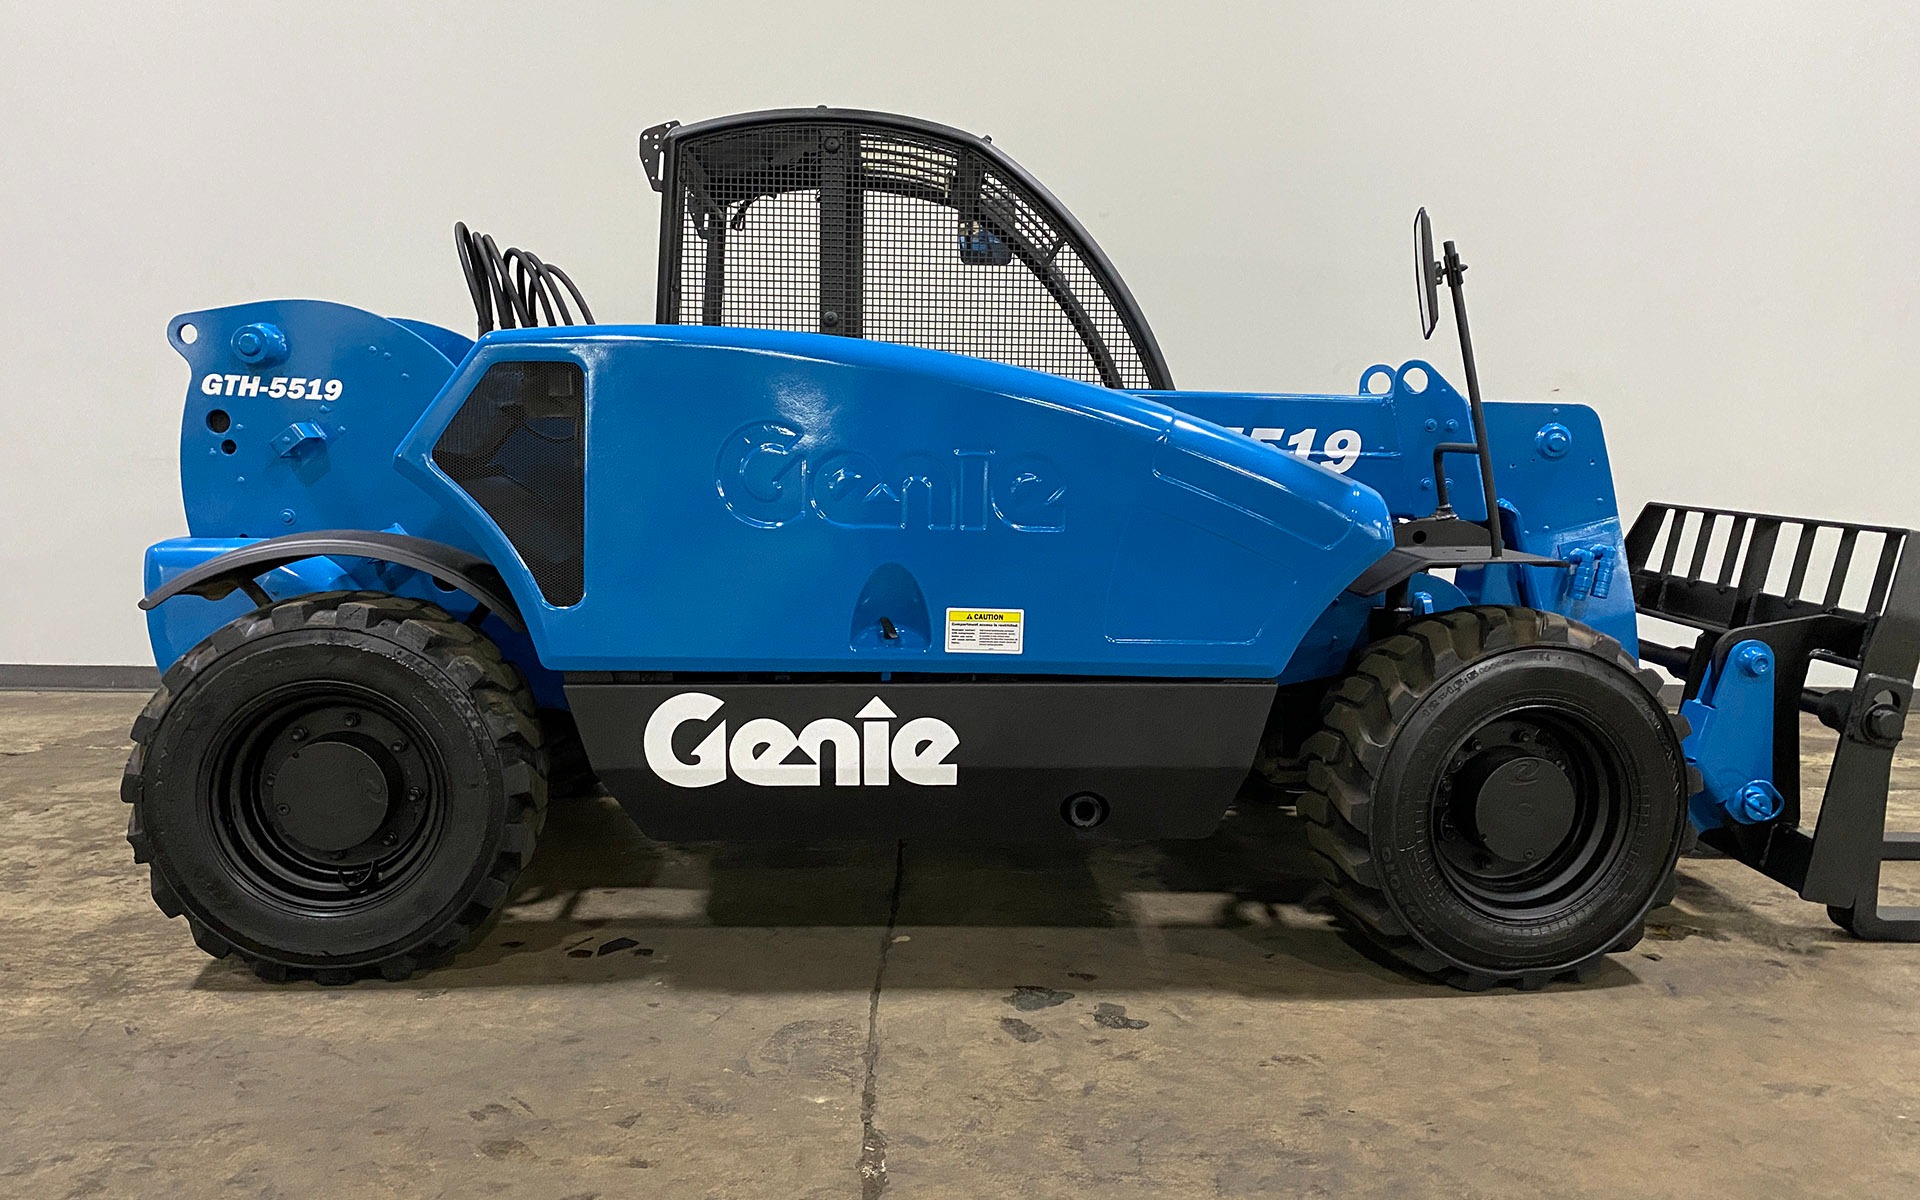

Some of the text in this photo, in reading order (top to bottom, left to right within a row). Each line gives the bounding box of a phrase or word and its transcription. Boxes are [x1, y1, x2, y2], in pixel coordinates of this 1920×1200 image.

[201, 373, 343, 401] GTH-5519
[1223, 427, 1362, 475] 519
[714, 419, 1066, 533] Genie
[974, 613, 1004, 621] CAUTION
[643, 692, 961, 789] Genie
